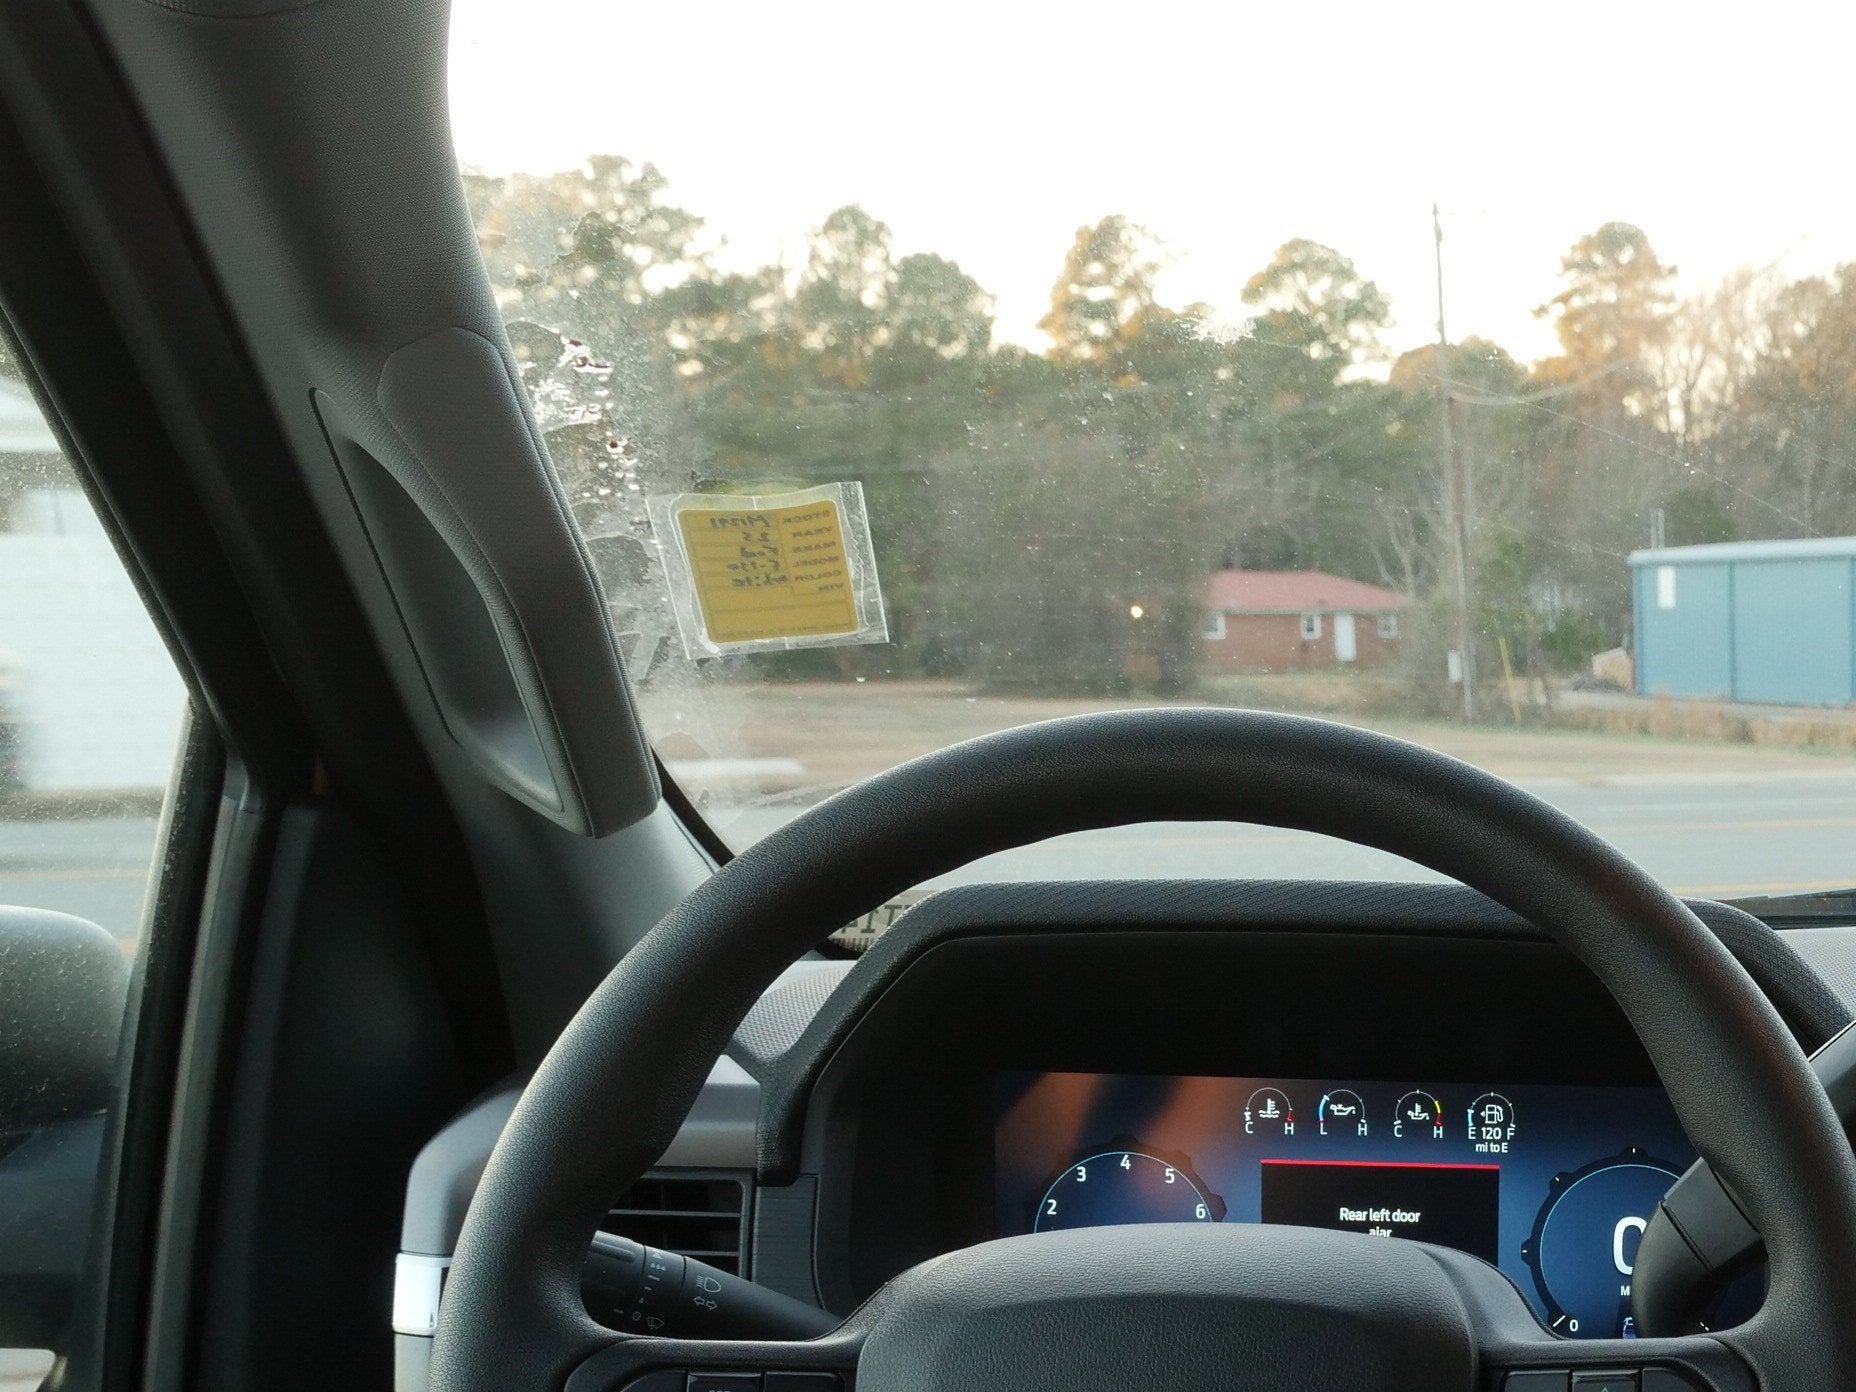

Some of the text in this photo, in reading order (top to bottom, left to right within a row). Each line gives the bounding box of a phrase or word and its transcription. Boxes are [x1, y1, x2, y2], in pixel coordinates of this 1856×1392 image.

[1245, 1122, 1253, 1134] C
[1285, 1123, 1294, 1135] H
[1320, 1124, 1327, 1135] L
[1358, 1124, 1367, 1136] H
[1394, 1125, 1402, 1137] C
[1434, 1126, 1443, 1138] H
[1468, 1127, 1476, 1139] E
[1481, 1127, 1501, 1140] 120
[1507, 1128, 1515, 1140] F
[1490, 1143, 1500, 1153] to
[1501, 1142, 1508, 1153] E
[1120, 1154, 1131, 1170] 4
[1076, 1166, 1086, 1182] 3
[1165, 1168, 1175, 1184] 5
[1047, 1199, 1057, 1215] 2
[1196, 1204, 1206, 1219] 6
[1339, 1208, 1420, 1223] Rear left door
[1569, 1319, 1579, 1332] 0
